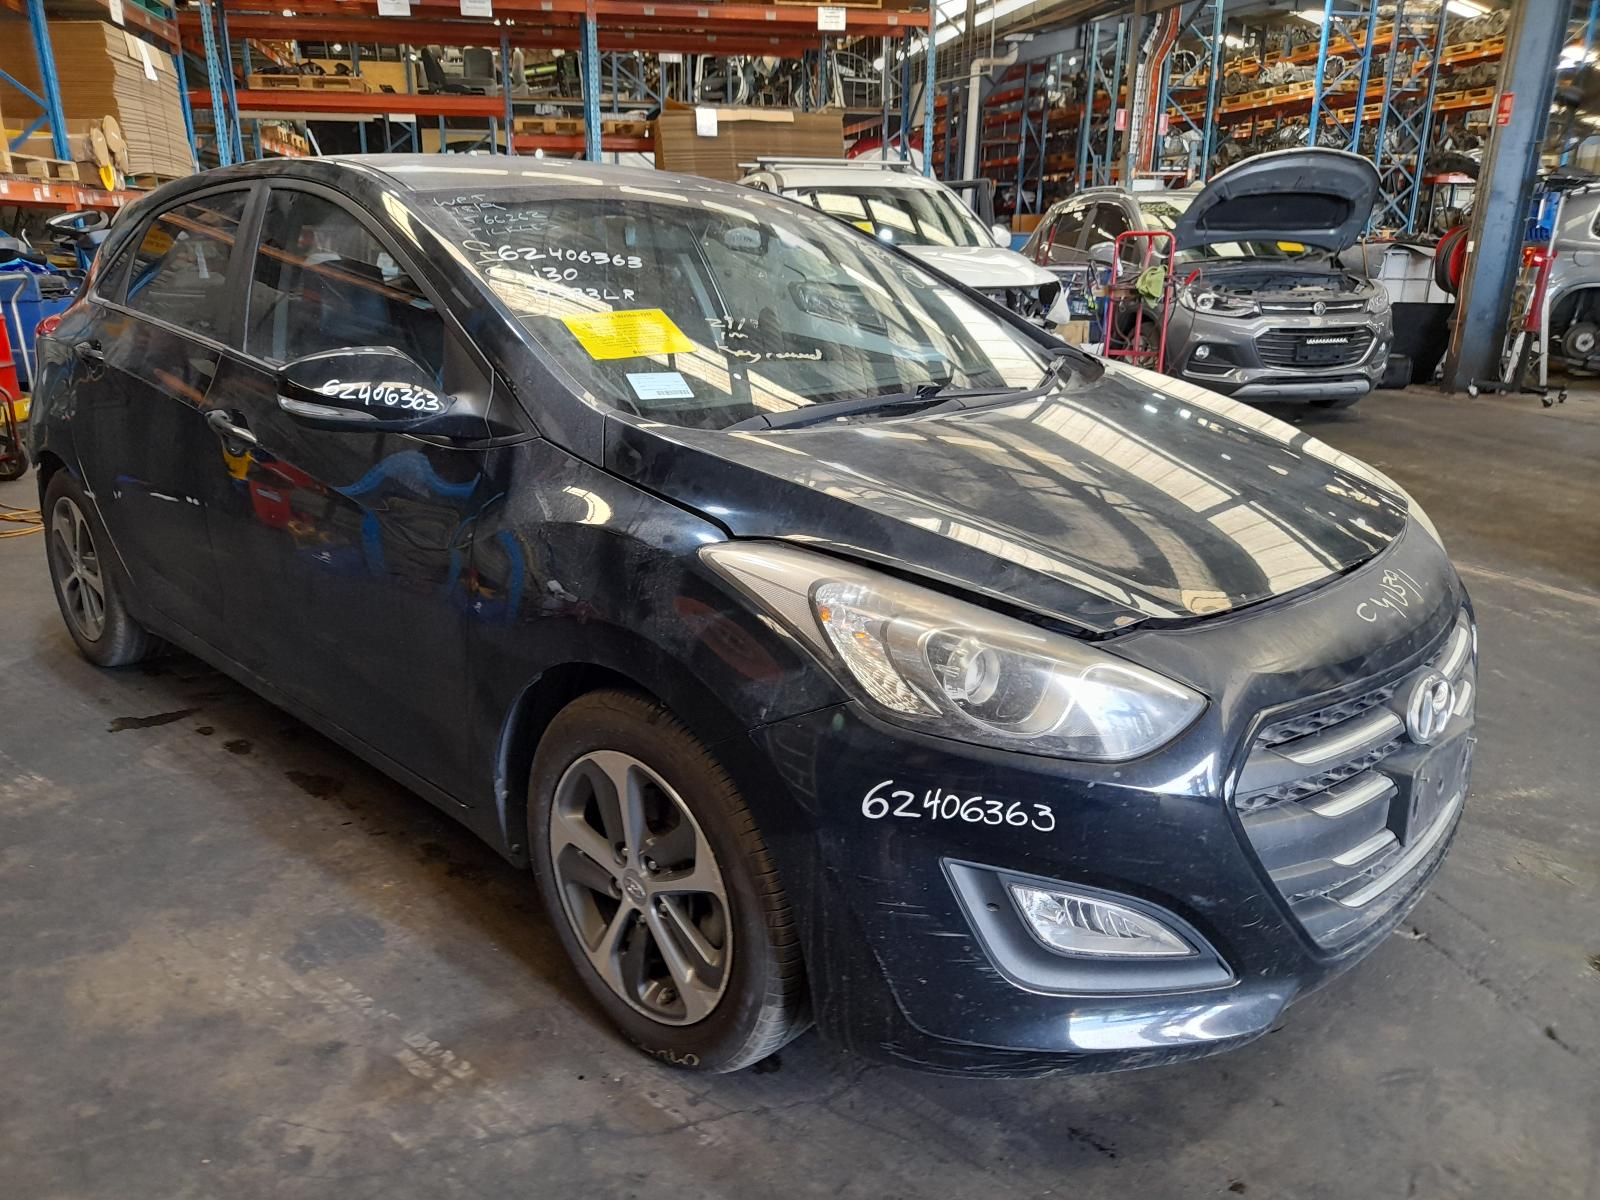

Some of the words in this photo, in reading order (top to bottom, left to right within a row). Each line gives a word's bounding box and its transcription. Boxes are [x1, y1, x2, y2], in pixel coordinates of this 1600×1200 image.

[497, 244, 643, 269] 62406363
[530, 264, 578, 282] i30
[321, 379, 441, 412] 62406363
[861, 779, 1056, 832] 62406363
